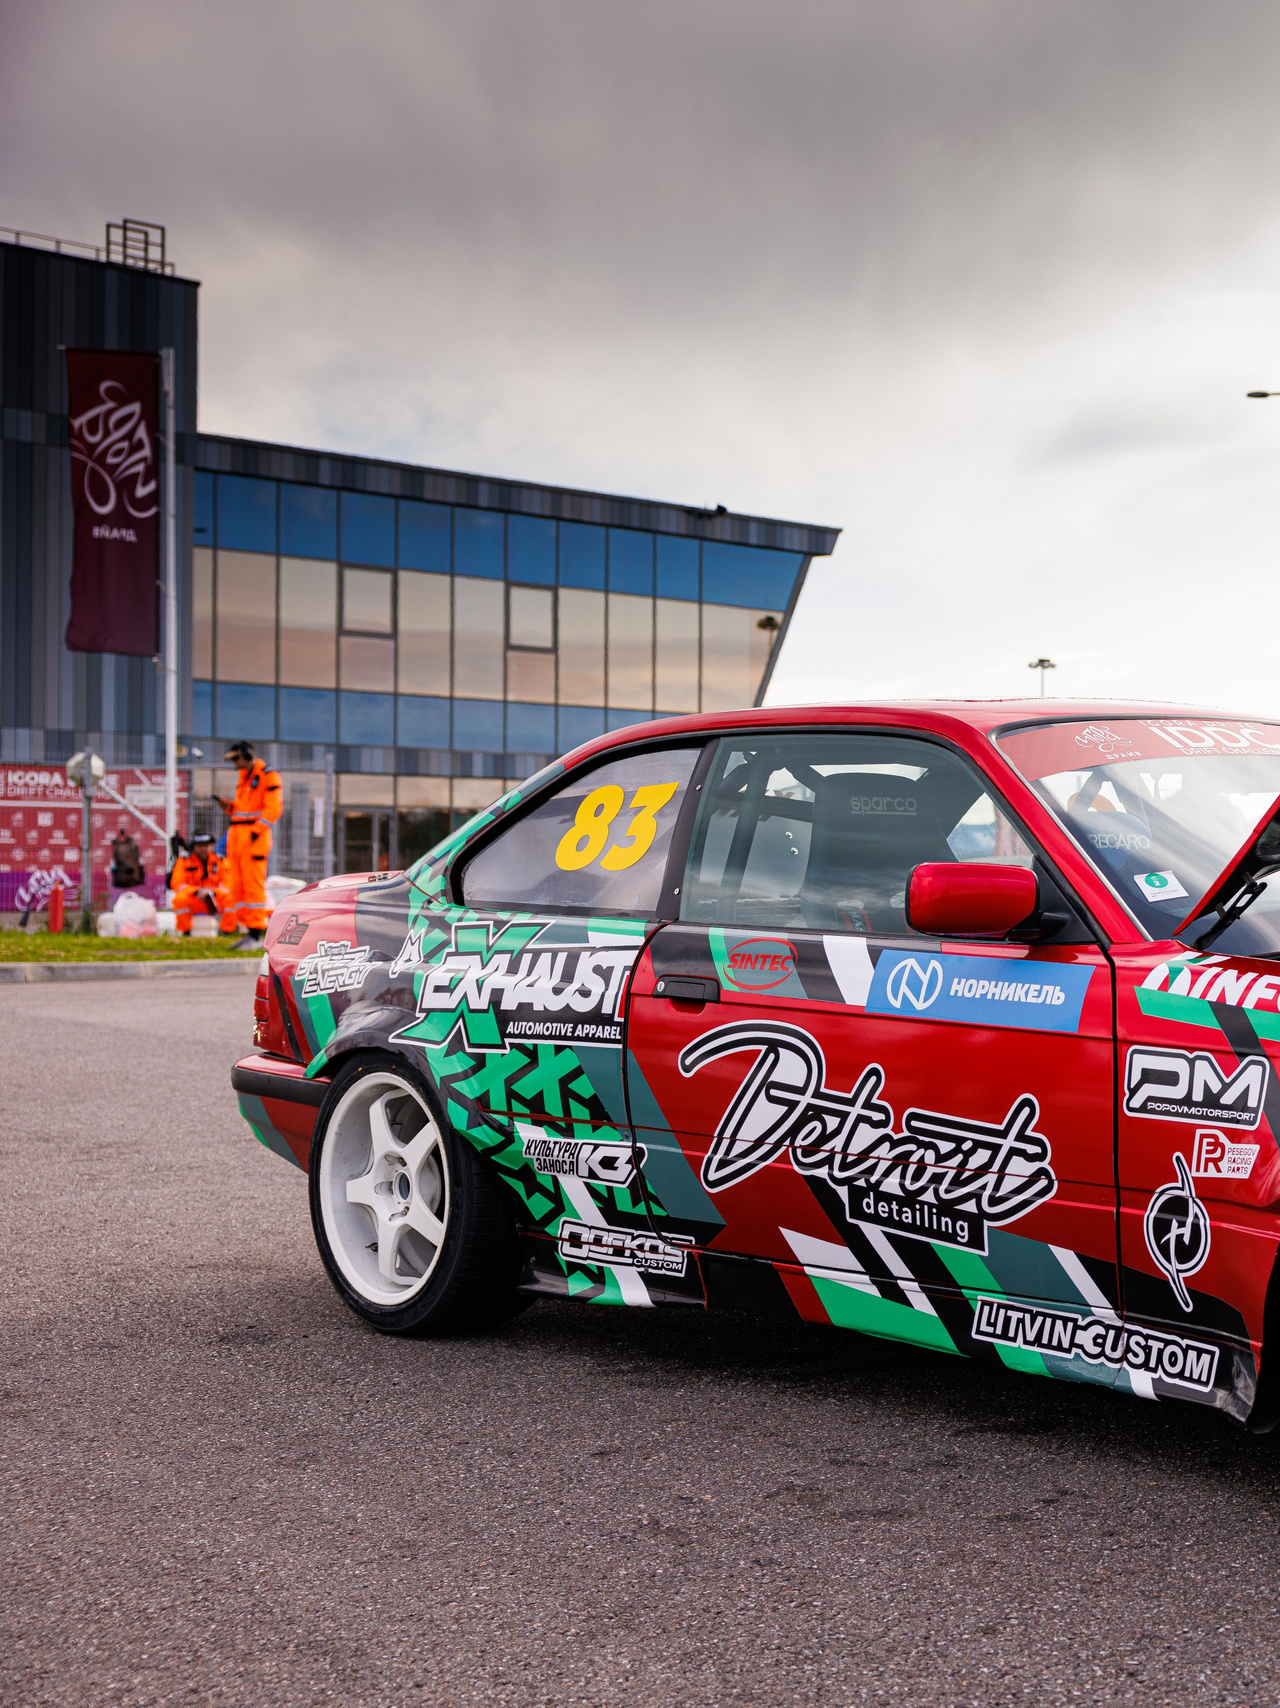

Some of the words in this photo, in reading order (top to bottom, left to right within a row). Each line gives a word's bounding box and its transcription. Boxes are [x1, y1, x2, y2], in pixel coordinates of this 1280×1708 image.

[1106, 751, 1142, 760] ДРАЙВ
[1178, 747, 1226, 757] DRIFT
[8, 769, 64, 786] IGORA
[8, 785, 43, 797] DRIFT
[851, 796, 918, 816] sparco
[555, 782, 680, 871] 83
[1093, 832, 1151, 850] RECARO
[727, 954, 794, 972] SINTEC
[421, 949, 637, 1014] EXHAUST
[949, 977, 1065, 1006] НОРНИКЕЛЬ
[506, 1021, 574, 1037] AUTOMOTIVE
[574, 1023, 622, 1040] APPAREL
[1129, 1051, 1264, 1108] PM
[1146, 1102, 1256, 1121] POPOVMOTORSPORT
[678, 1019, 1058, 1226] Detroit
[524, 1139, 580, 1159] КУЛЬТУРА
[1227, 1147, 1256, 1156] PESEGOV
[536, 1158, 576, 1175] ЗАНОСА
[1227, 1157, 1252, 1165] RACING
[1227, 1166, 1249, 1175] PARTS
[862, 1192, 970, 1243] detailing
[633, 1258, 682, 1271] CUSTOM
[979, 1302, 1074, 1349] LITVIN
[1075, 1323, 1212, 1383] CUSTOM
